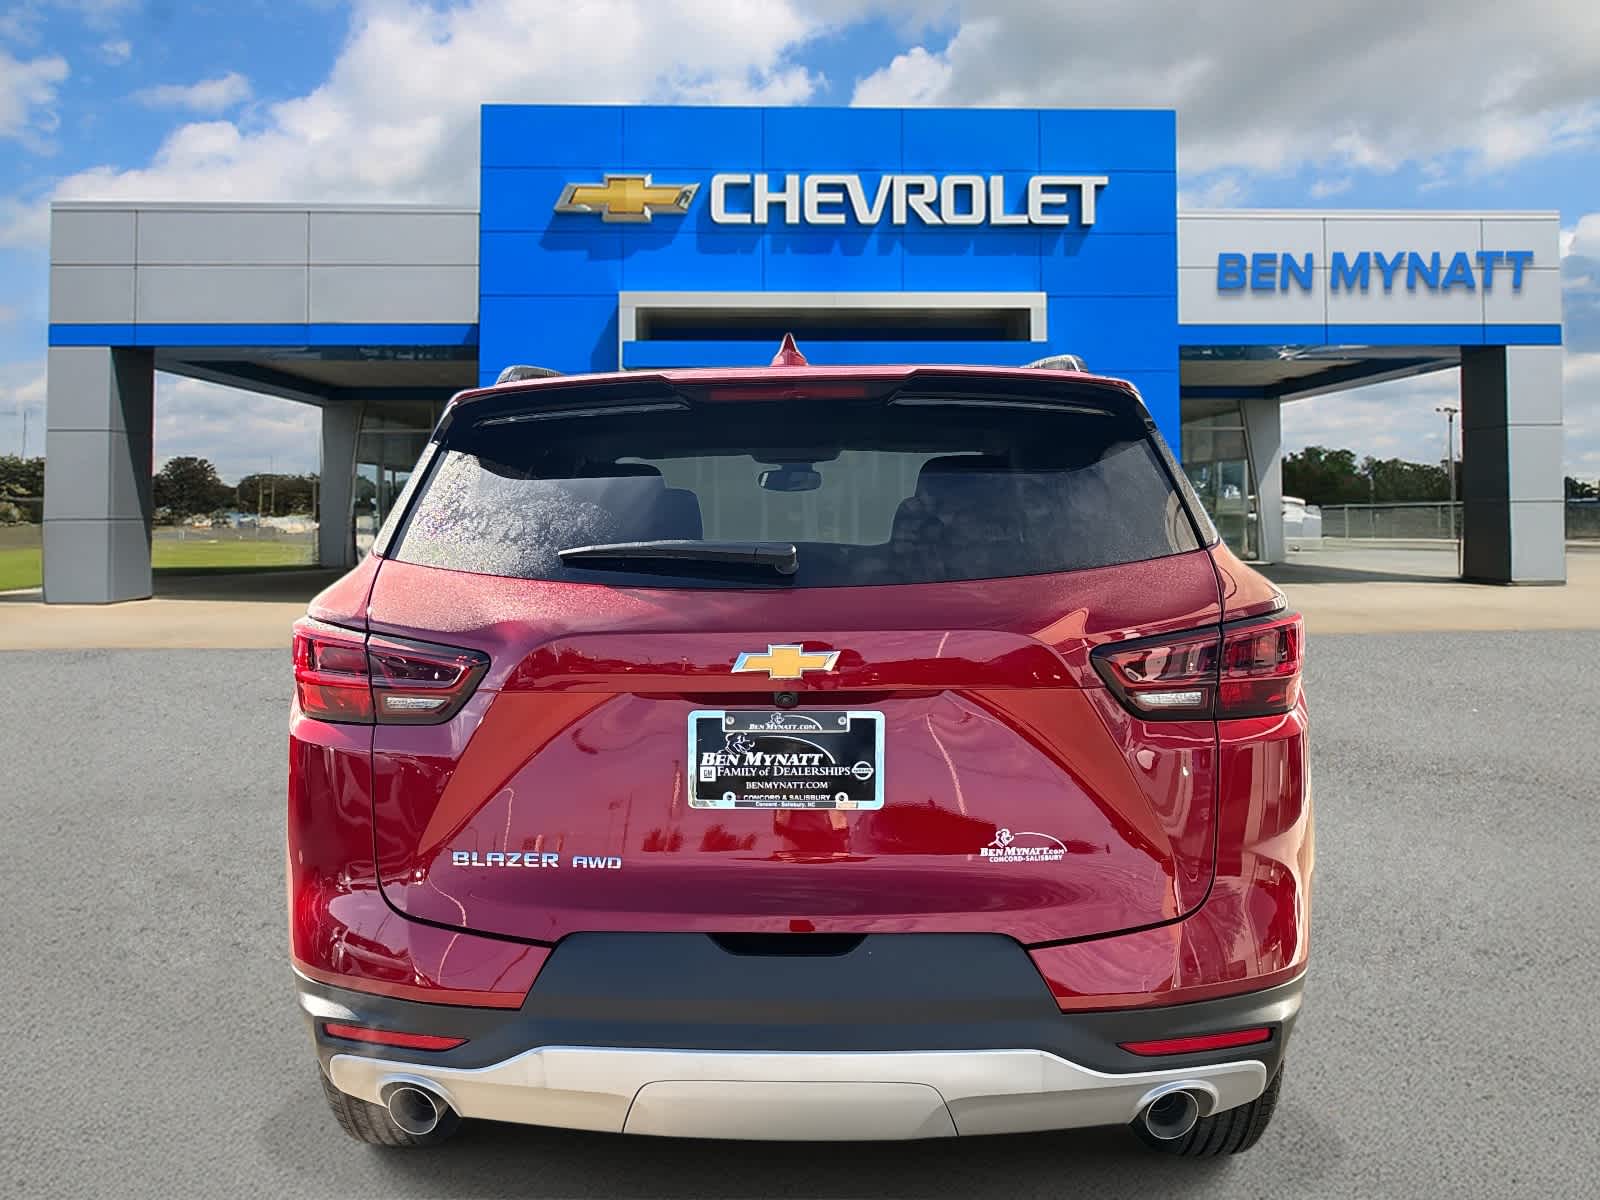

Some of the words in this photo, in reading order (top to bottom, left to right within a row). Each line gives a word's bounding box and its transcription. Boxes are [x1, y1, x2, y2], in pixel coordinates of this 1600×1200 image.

[710, 174, 1109, 225] CHEVROLET
[1217, 252, 1314, 291] BEN
[1330, 250, 1535, 291] MYNATT
[700, 752, 740, 766] BEN
[743, 751, 824, 766] MYNATT
[717, 766, 757, 777] FAMILY
[758, 766, 770, 777] of
[773, 766, 851, 777] DEALERSHIPS
[745, 781, 829, 790] BENMYNATT.COM
[452, 851, 559, 868] BLAZER
[572, 856, 622, 869] AWD
[980, 848, 1004, 857] BEN
